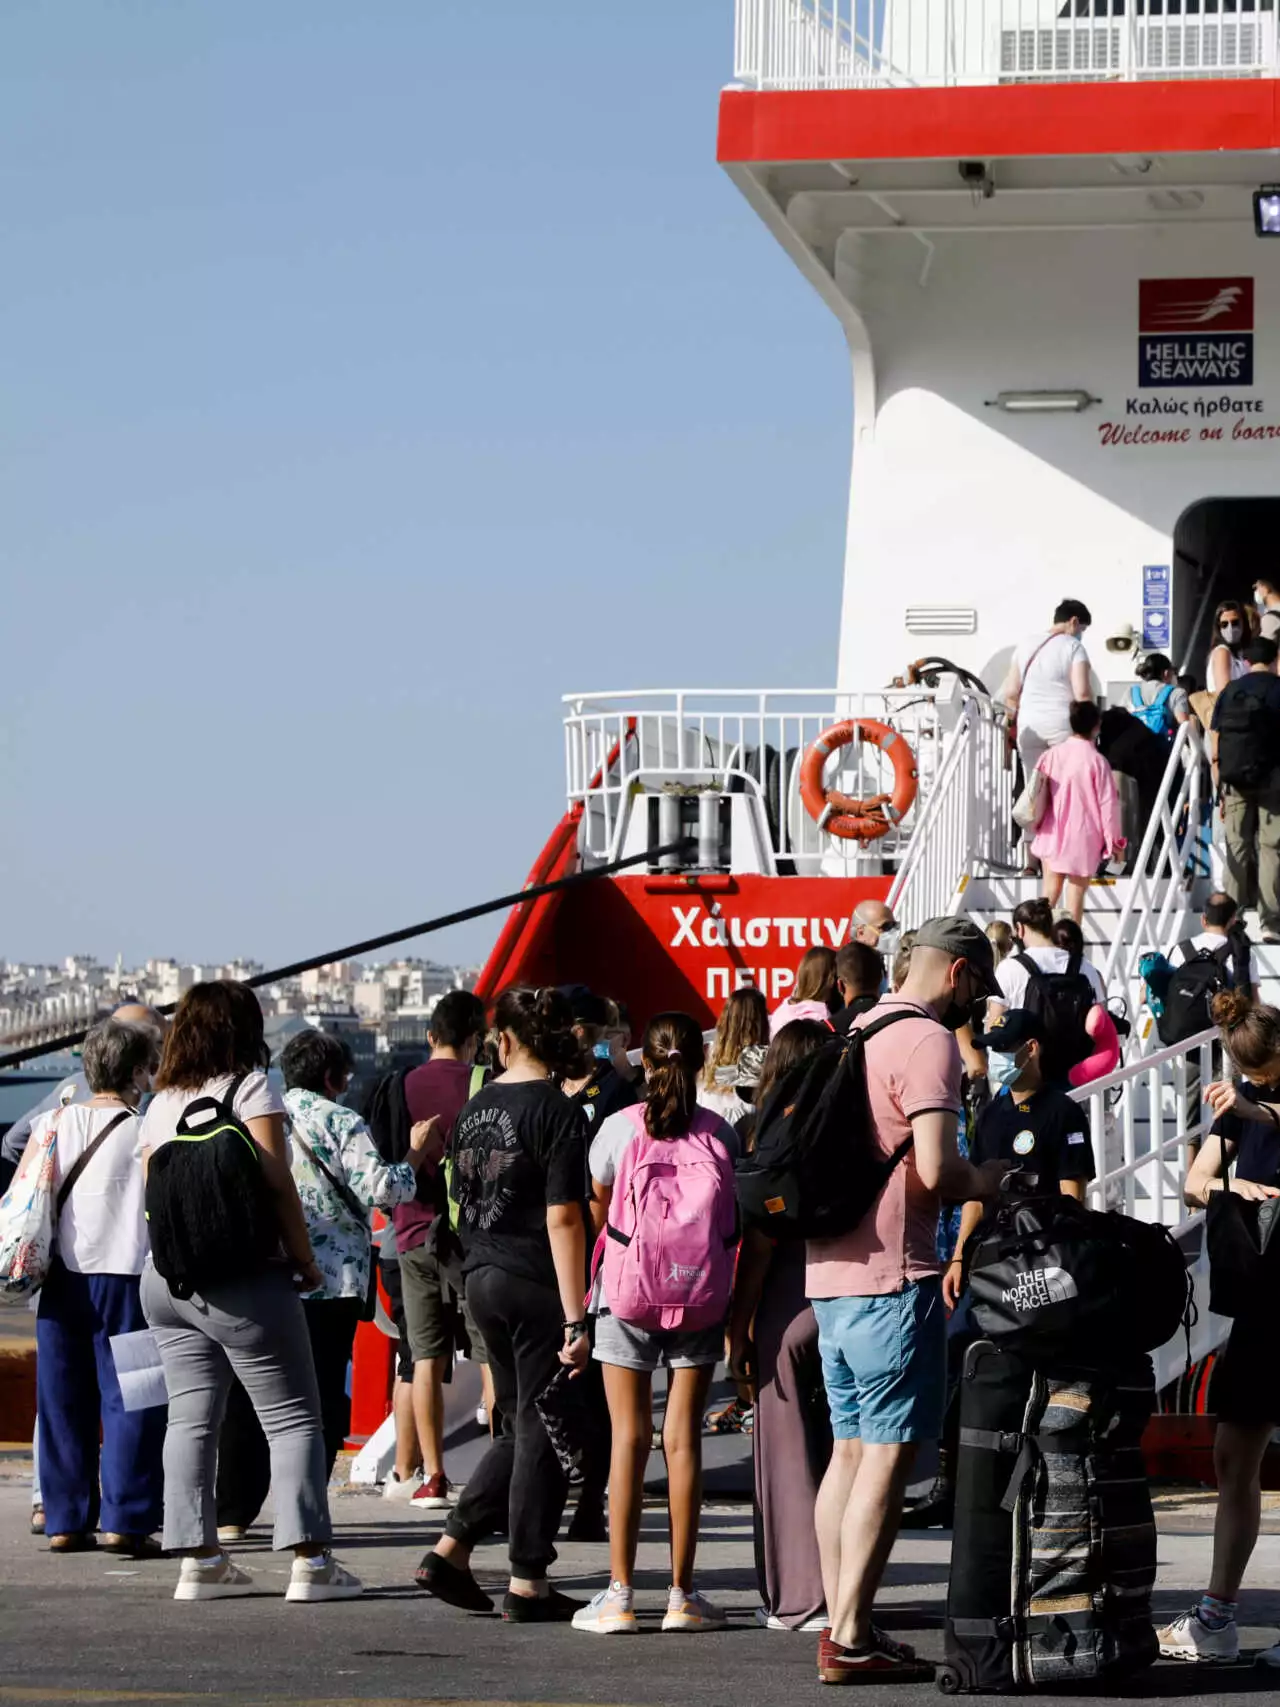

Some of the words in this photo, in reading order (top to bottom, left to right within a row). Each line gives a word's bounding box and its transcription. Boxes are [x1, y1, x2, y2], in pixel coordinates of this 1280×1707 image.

[1146, 342, 1246, 361] HELLENIC
[1150, 360, 1241, 379] SEAWAYS
[1126, 398, 1188, 416] Καλώς
[1194, 397, 1264, 418] ήρθατε
[1098, 422, 1191, 446] Welcome
[1199, 426, 1224, 441] on
[670, 902, 849, 947] Χάισπιν
[706, 967, 796, 998] ΠΕΙΡ
[1015, 1268, 1044, 1287] THE
[1002, 1279, 1047, 1303] NORTH
[1014, 1292, 1050, 1312] FACE
